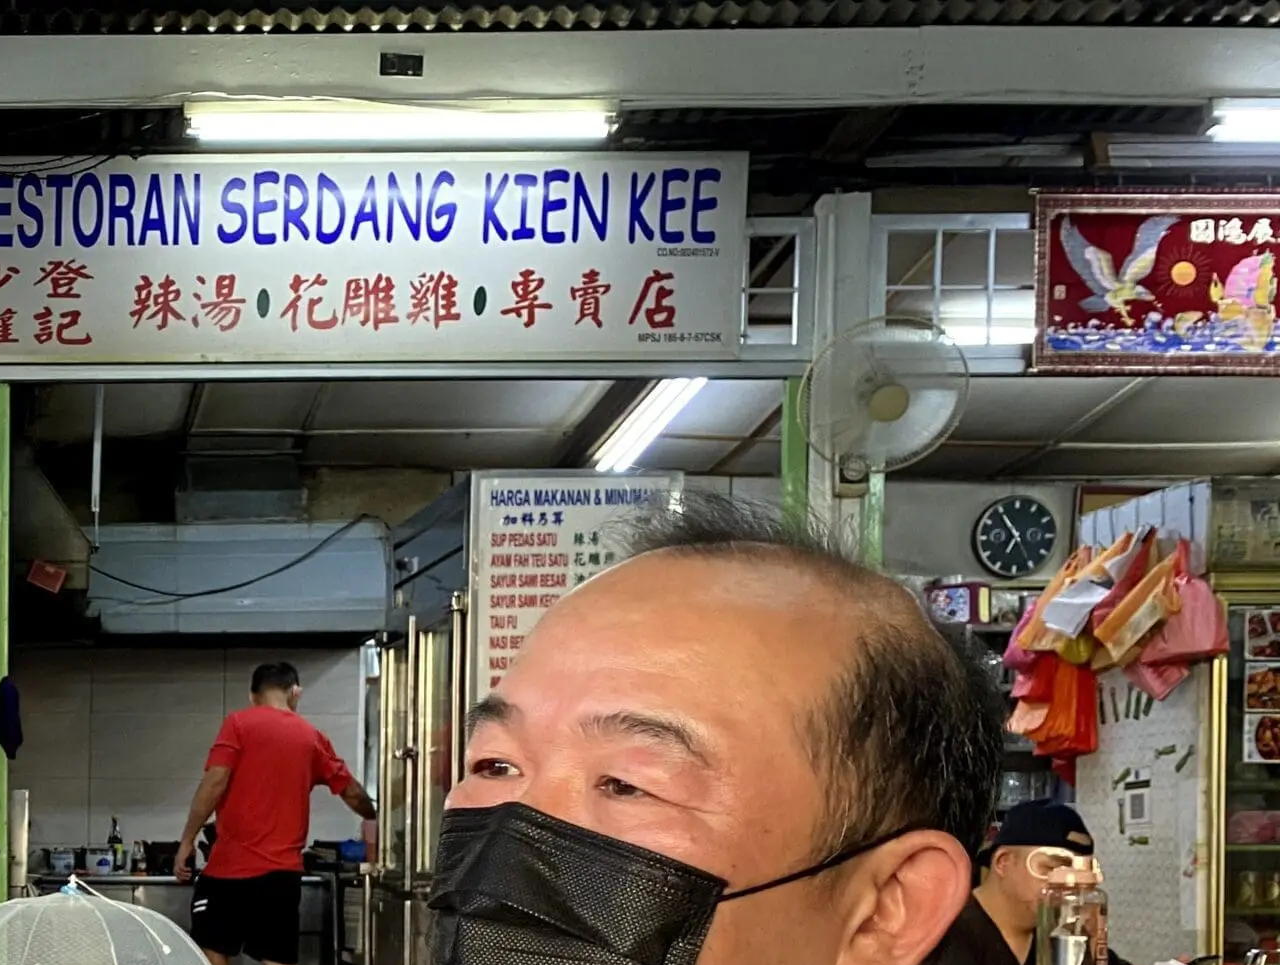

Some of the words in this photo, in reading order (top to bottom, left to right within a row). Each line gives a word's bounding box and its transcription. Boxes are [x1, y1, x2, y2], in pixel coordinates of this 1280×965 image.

[217, 170, 458, 245] SERDANG
[483, 169, 610, 245] KIEN
[629, 168, 721, 244] KEE
[129, 273, 246, 332] 辣湯
[280, 270, 462, 332] 花雕雞
[490, 489, 530, 507] HARGA
[534, 489, 591, 507] MAKANAN
[594, 489, 602, 505] &
[605, 488, 650, 506] MINUMA
[491, 533, 507, 548] SUP
[508, 532, 535, 547] PEDAS
[537, 532, 558, 547] SATU
[491, 553, 512, 568] AYAM
[514, 553, 530, 567] FAH
[548, 552, 569, 567] SATU
[491, 574, 517, 589] SAYUR
[518, 574, 538, 588] SAWI
[540, 573, 567, 588] BESAR
[490, 594, 516, 609] SAYUR
[518, 594, 538, 608] SAWI
[490, 615, 506, 629] TAU
[507, 615, 518, 629] FU
[489, 636, 508, 650] NASI
[489, 657, 507, 670] NASI
